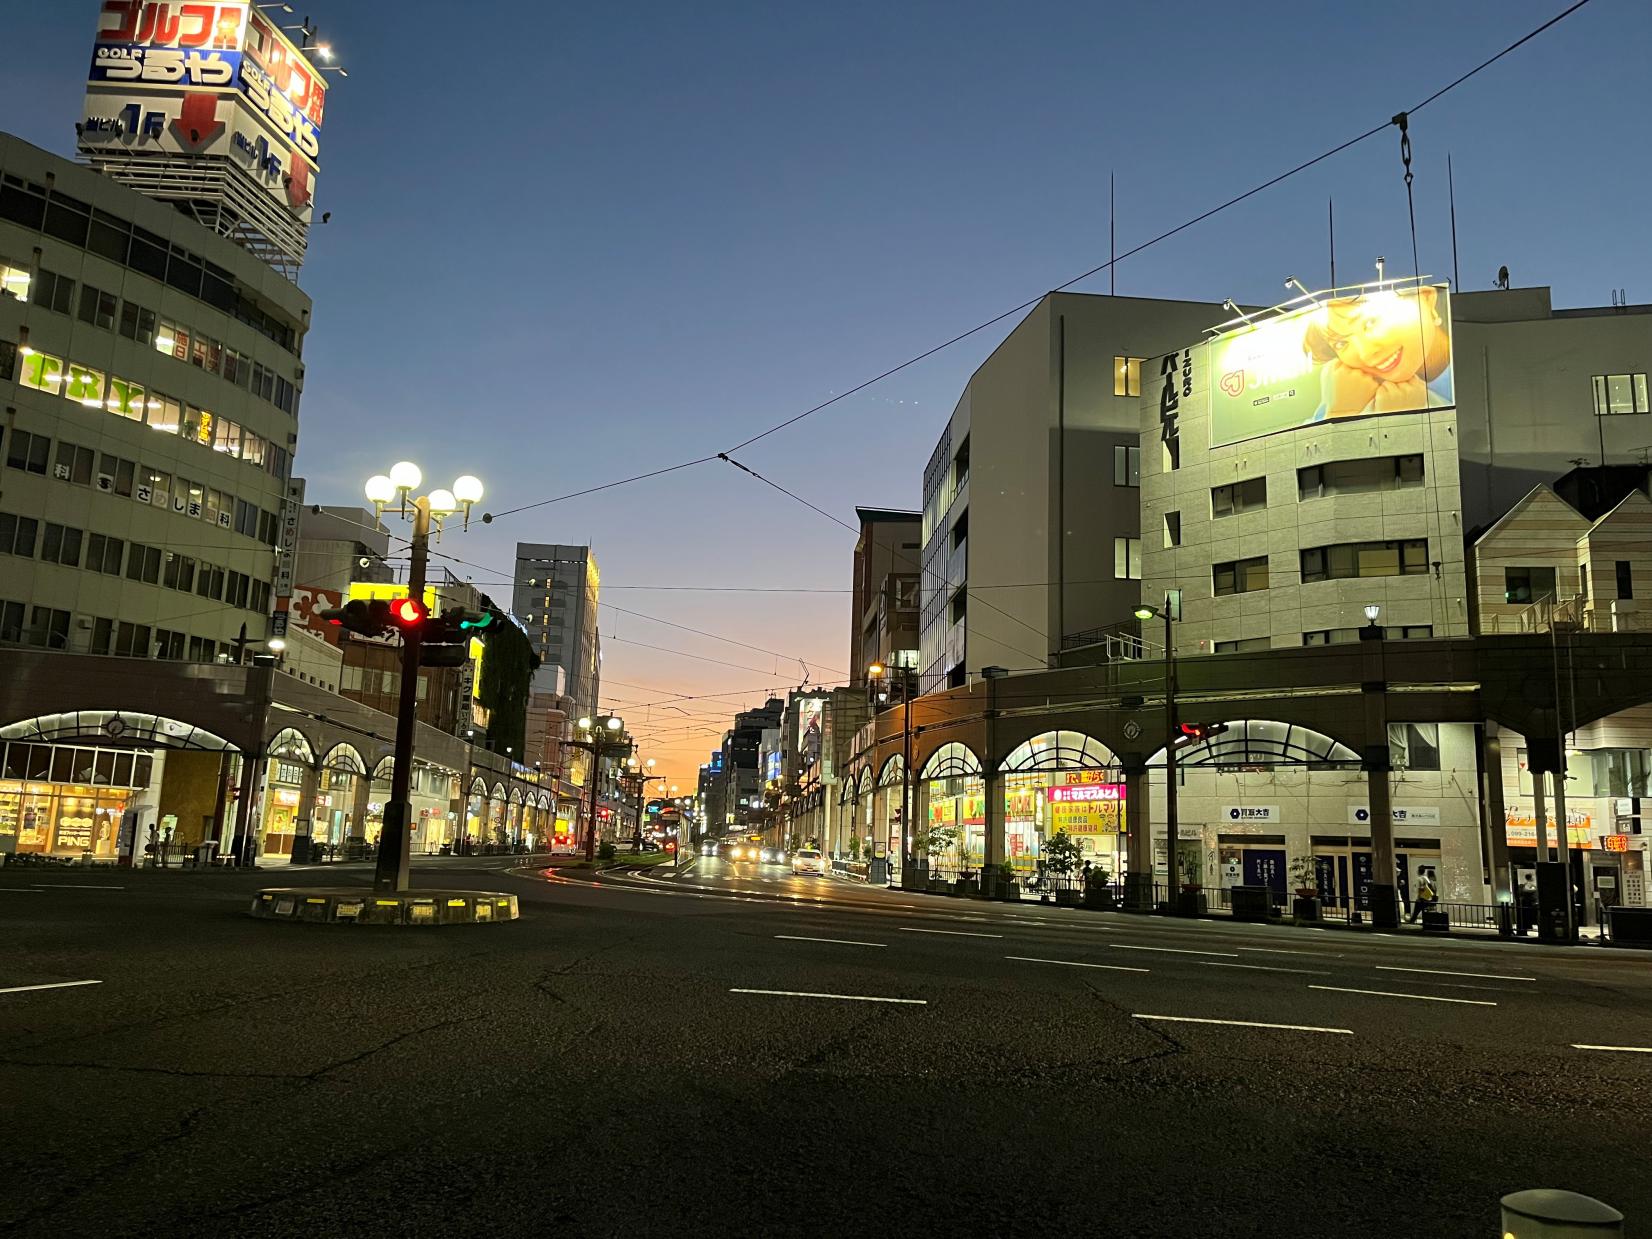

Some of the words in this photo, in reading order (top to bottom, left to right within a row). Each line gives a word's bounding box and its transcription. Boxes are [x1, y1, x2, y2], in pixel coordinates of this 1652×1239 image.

[95, 49, 233, 84] つるや
[98, 48, 142, 59] GOLF
[243, 60, 272, 91] GOLF
[241, 68, 319, 157] つるや
[24, 352, 144, 415] TRY
[58, 836, 91, 847] PING
